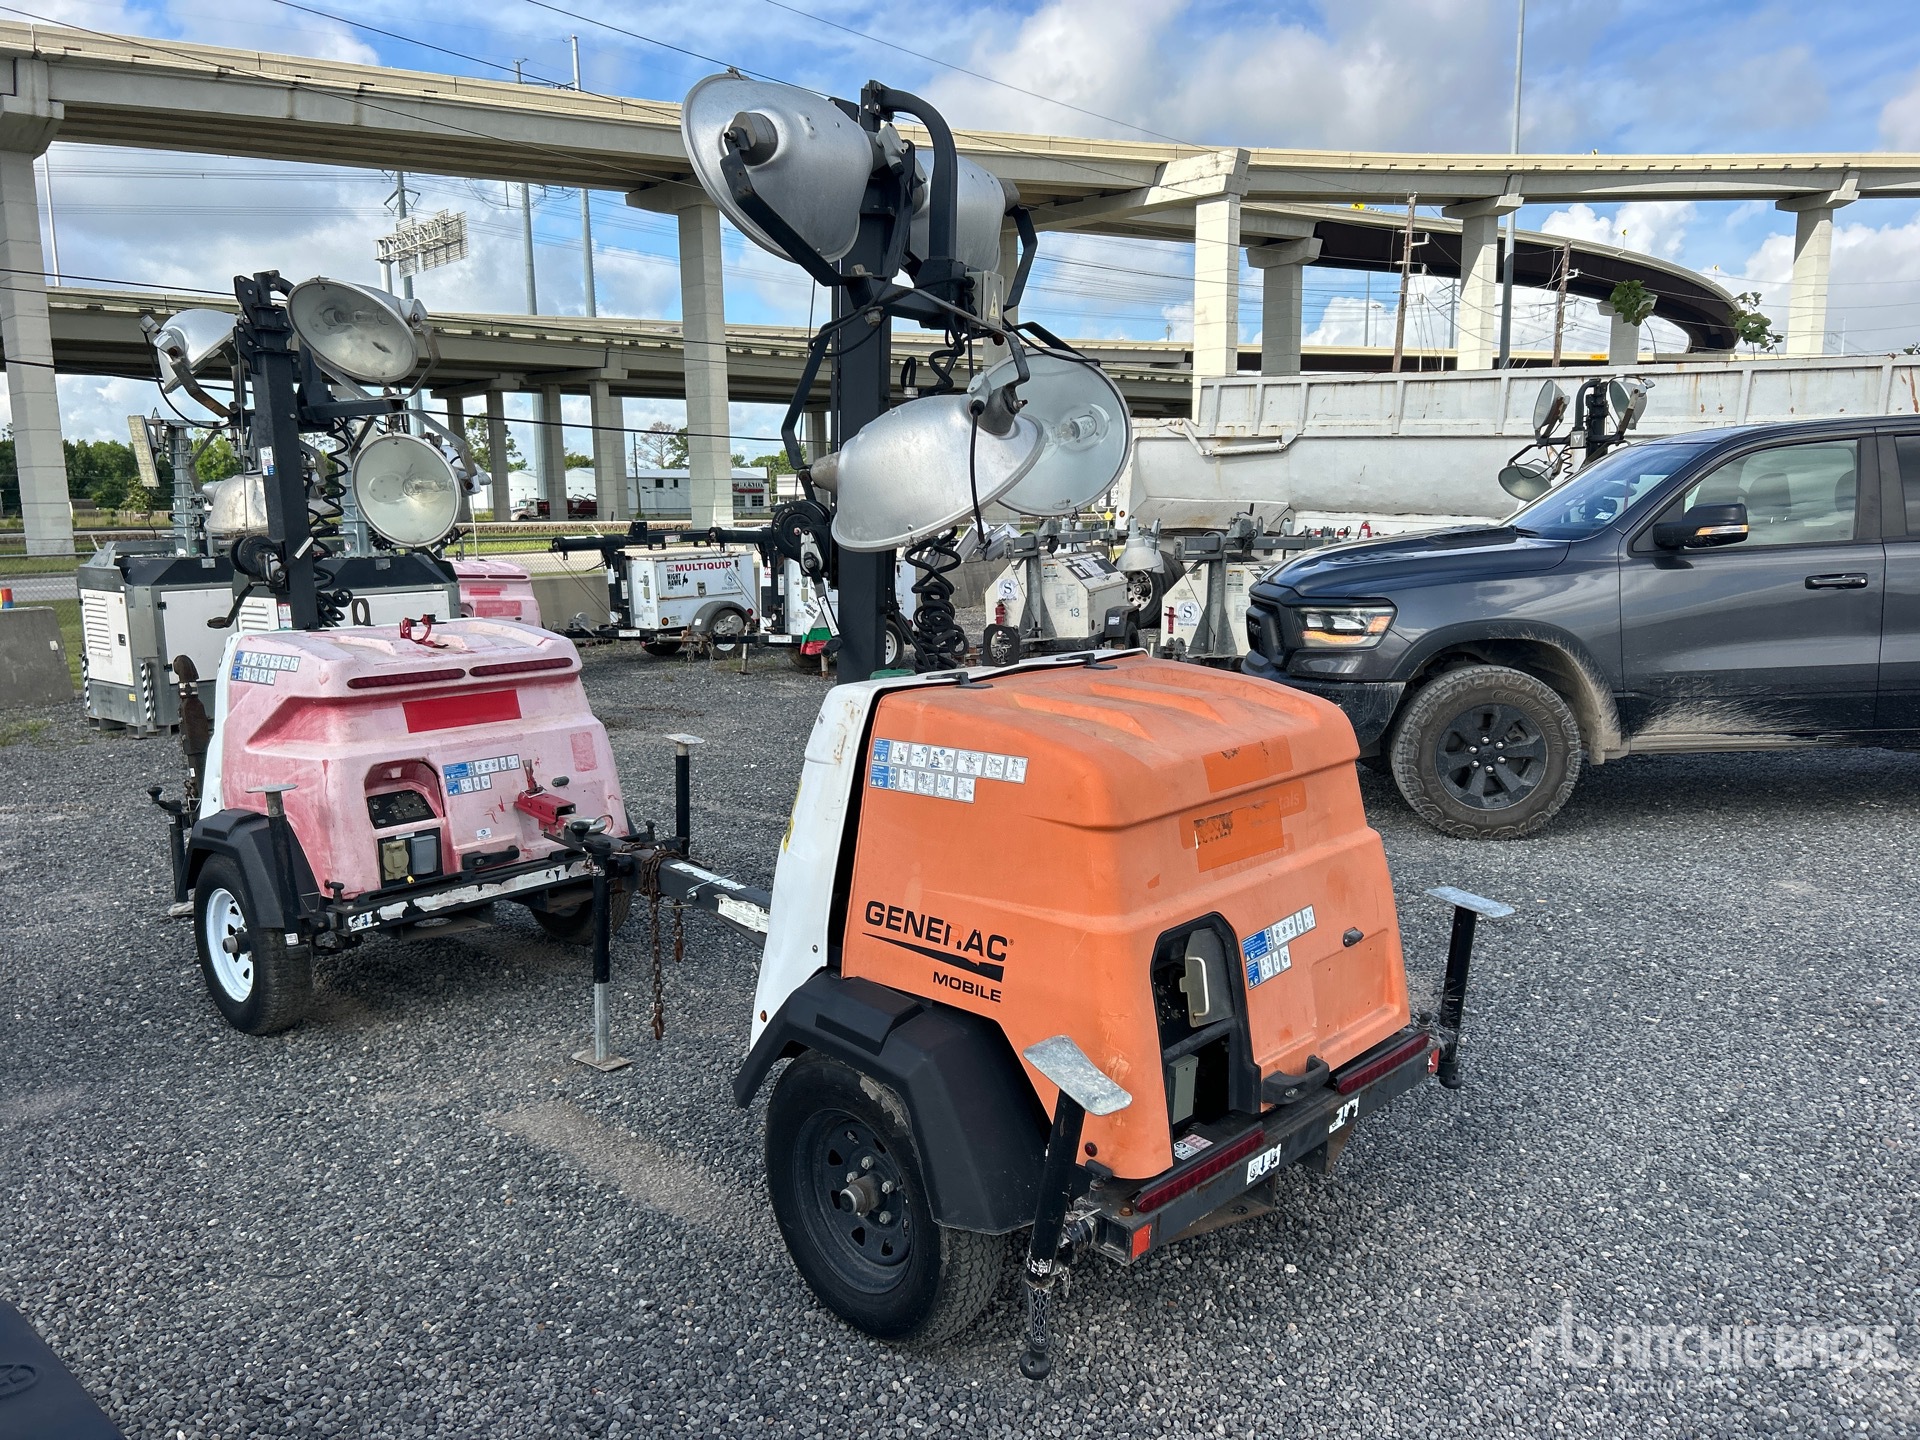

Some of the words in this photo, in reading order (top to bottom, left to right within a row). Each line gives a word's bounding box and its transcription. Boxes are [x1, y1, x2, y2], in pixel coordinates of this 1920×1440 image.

[675, 561, 732, 572] MULTIQUIP
[1069, 607, 1080, 618] 13
[1492, 689, 1564, 754] GOODYEAR
[932, 971, 1002, 1004] MOBILE
